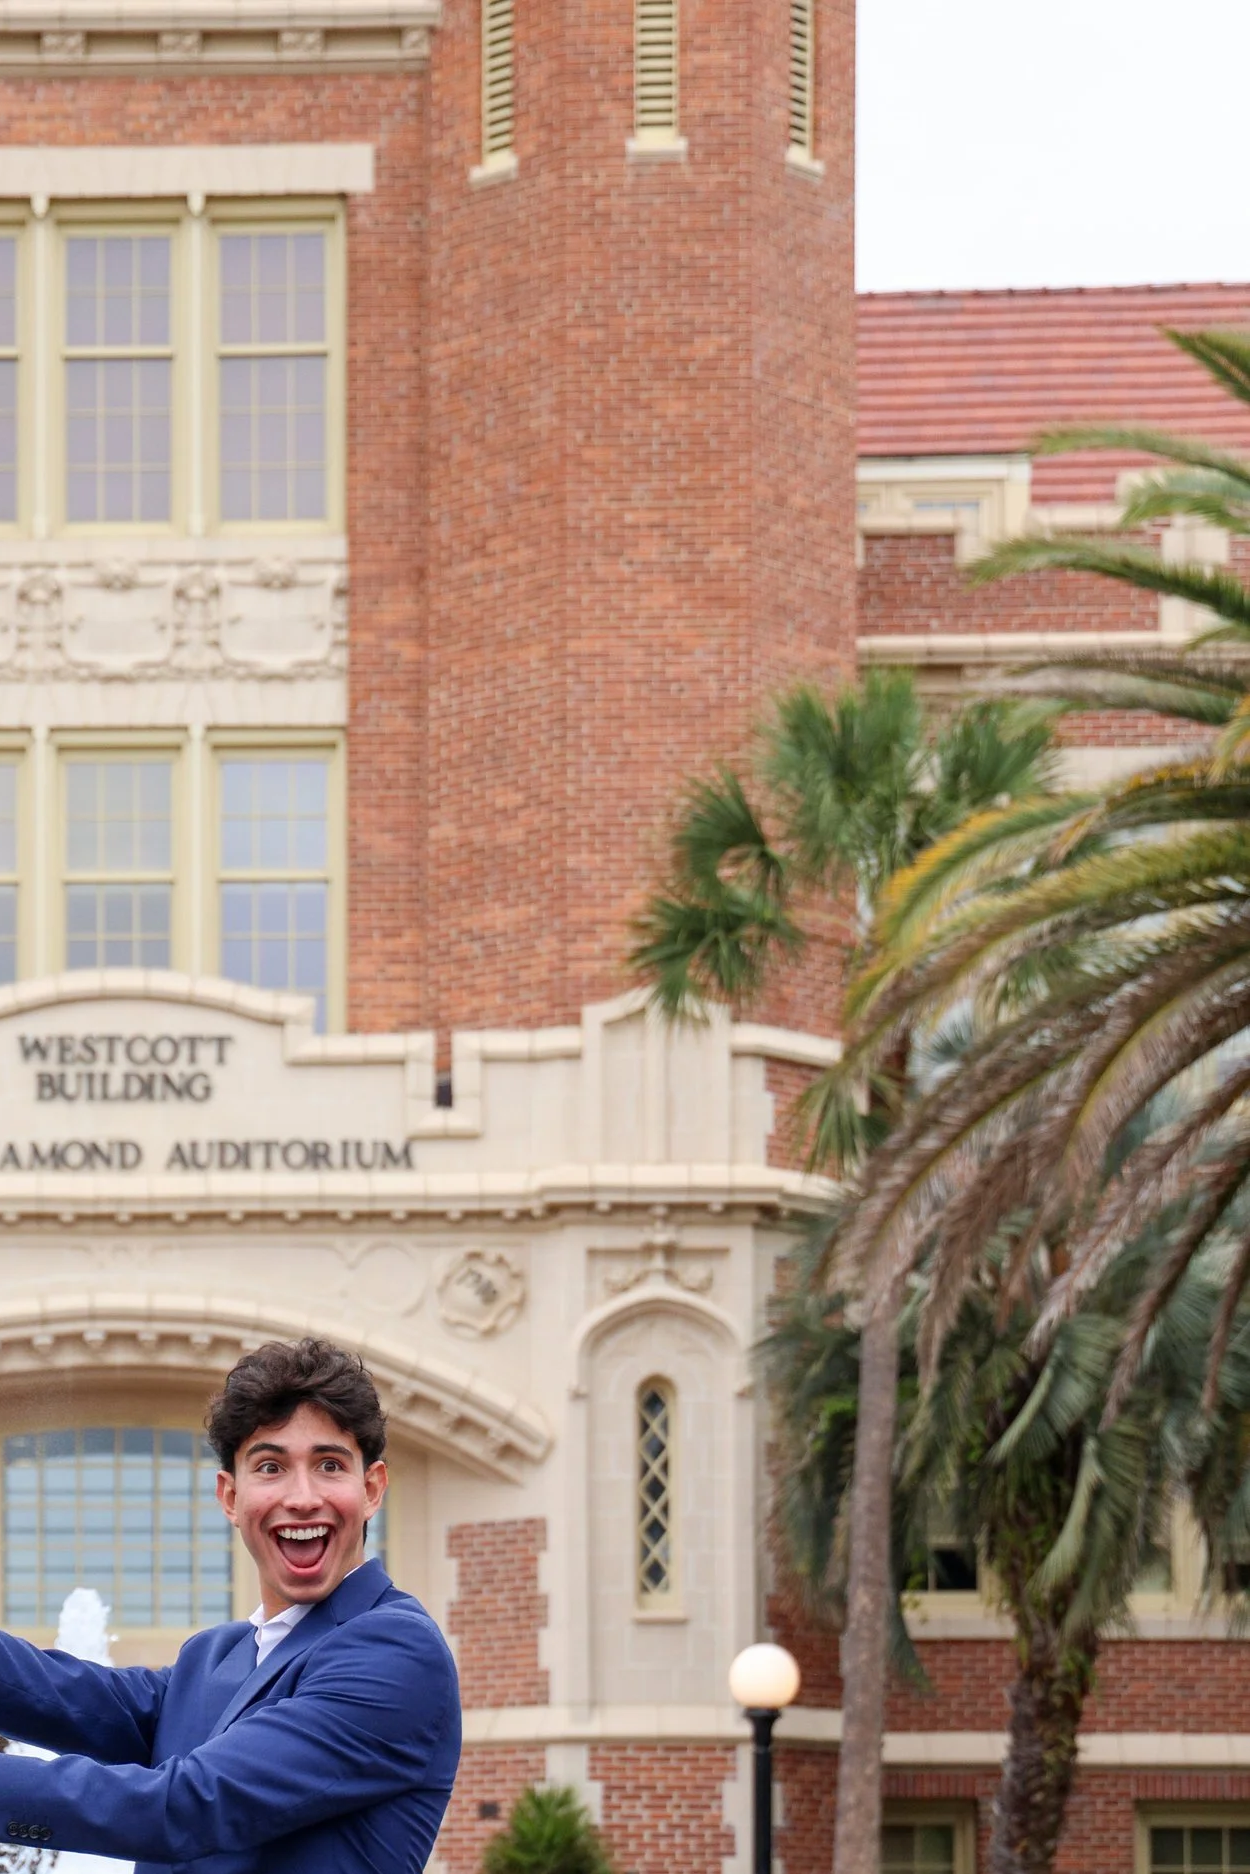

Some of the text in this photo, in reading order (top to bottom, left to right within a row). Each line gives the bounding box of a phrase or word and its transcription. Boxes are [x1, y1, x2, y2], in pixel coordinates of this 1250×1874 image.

[18, 1034, 233, 1065] WESTCOTT
[36, 1072, 213, 1102] BUILDING
[166, 1139, 417, 1170] AUDITORIUM
